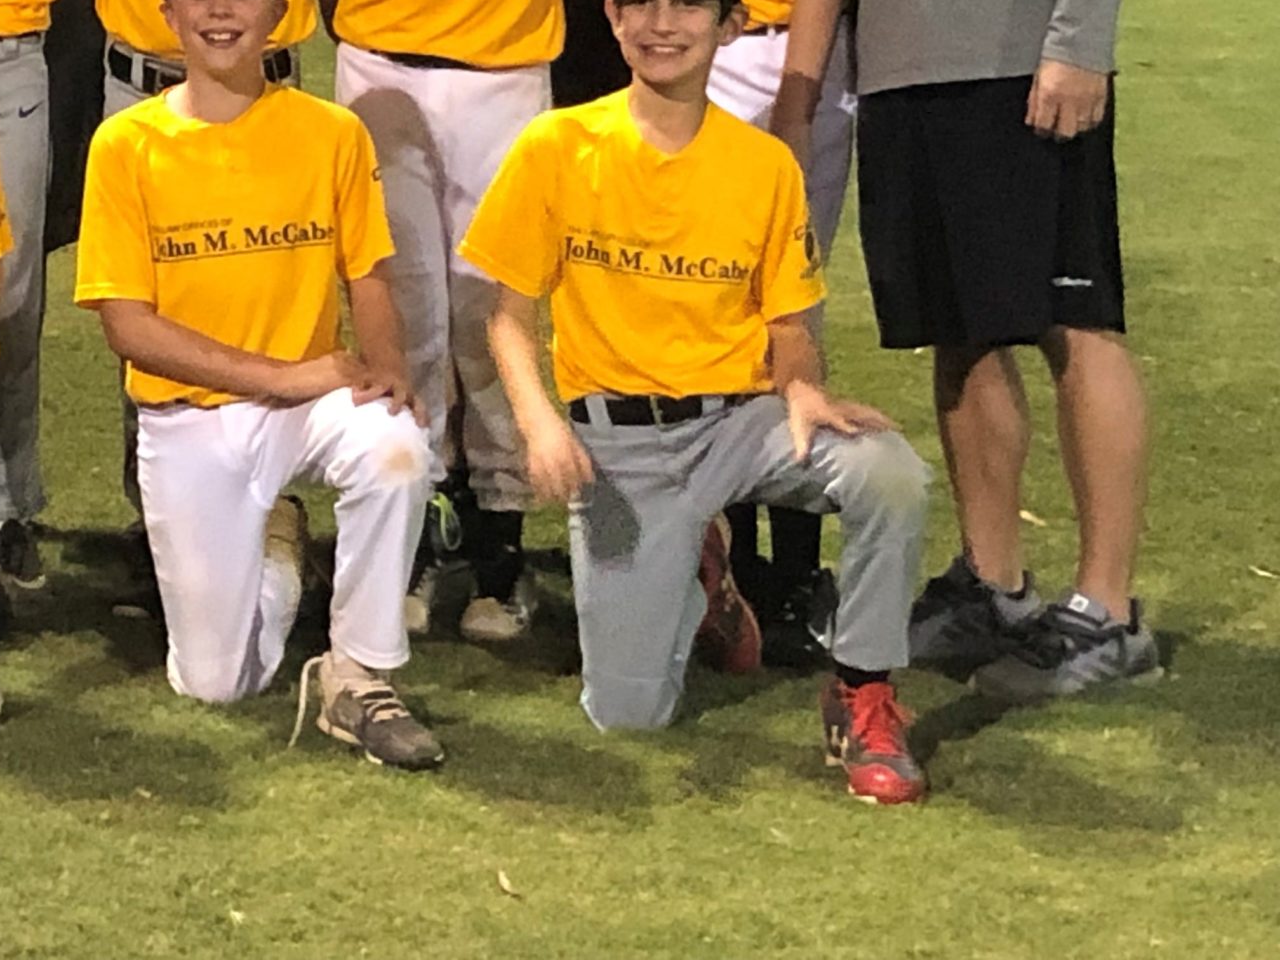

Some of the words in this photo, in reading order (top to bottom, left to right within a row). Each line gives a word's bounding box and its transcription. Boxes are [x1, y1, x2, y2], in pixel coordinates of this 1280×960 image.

[203, 230, 236, 252] M.
[565, 236, 610, 265] John
[618, 248, 649, 272] M.
